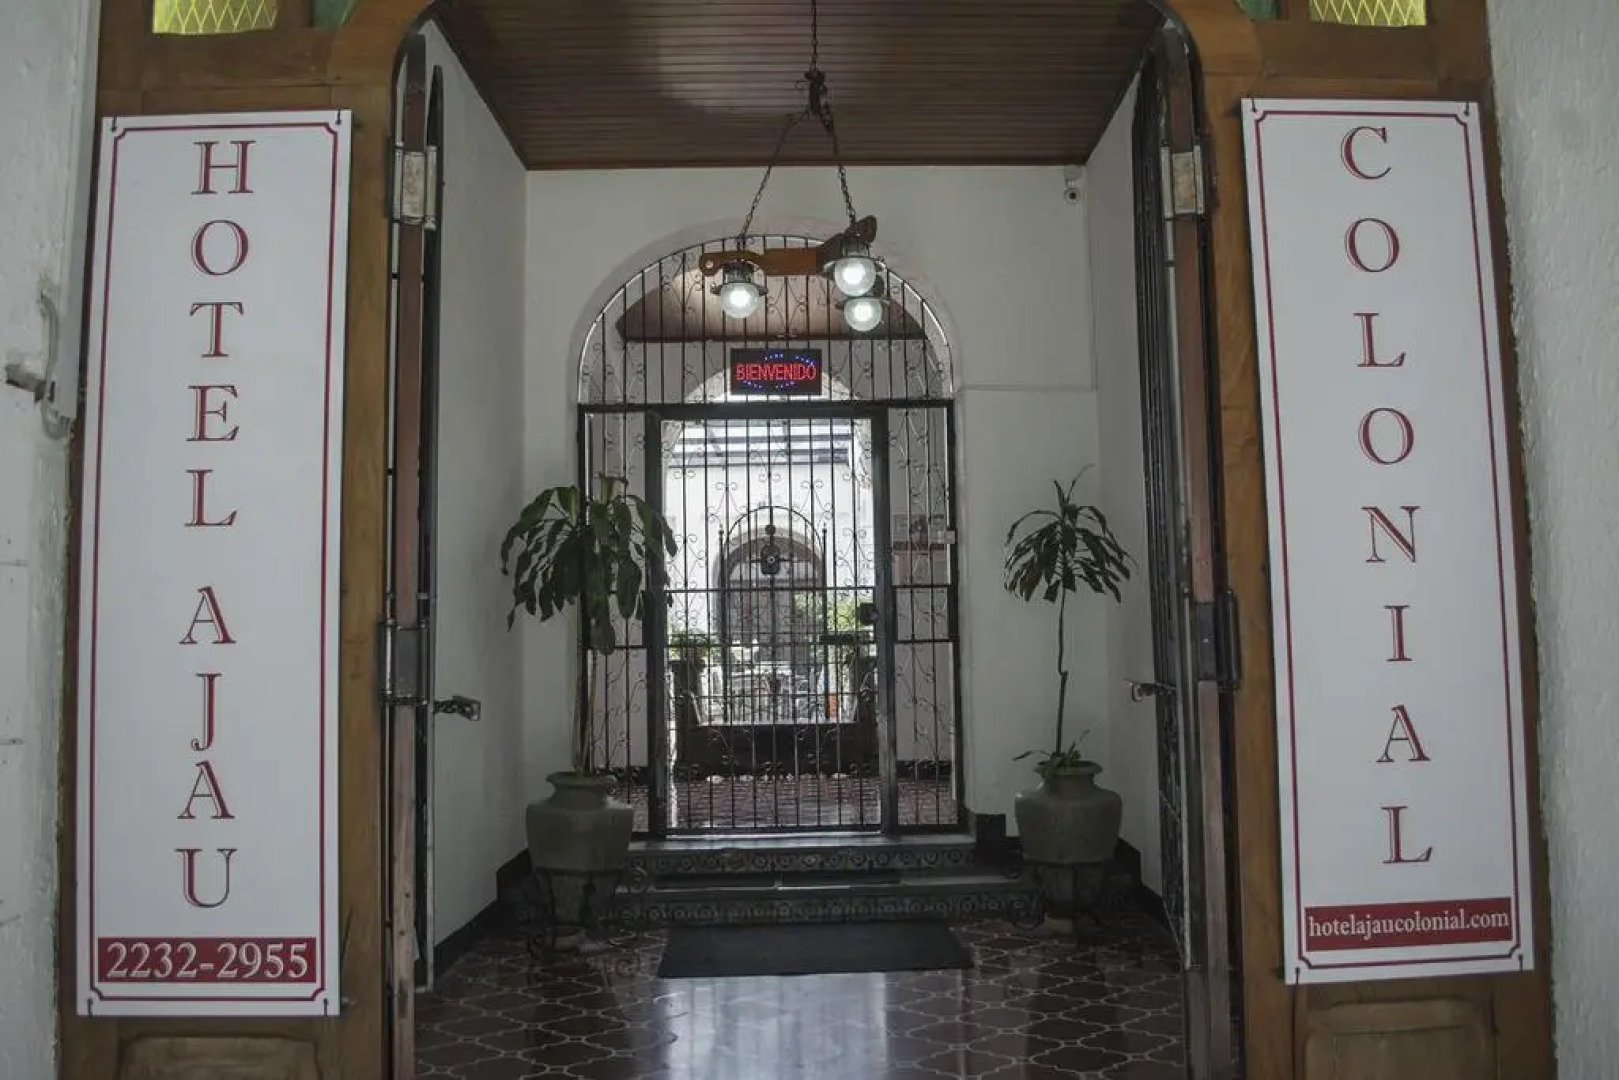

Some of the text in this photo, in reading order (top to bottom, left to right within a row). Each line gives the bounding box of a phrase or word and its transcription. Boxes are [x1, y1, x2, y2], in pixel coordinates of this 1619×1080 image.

[736, 362, 817, 380] BIENVENIDO
[1340, 126, 1433, 865] COLONIAL
[176, 140, 253, 908] HOTEL AJAU
[1308, 908, 1509, 940] hotelajaucolonial.com
[106, 942, 308, 978] 2232-2955
